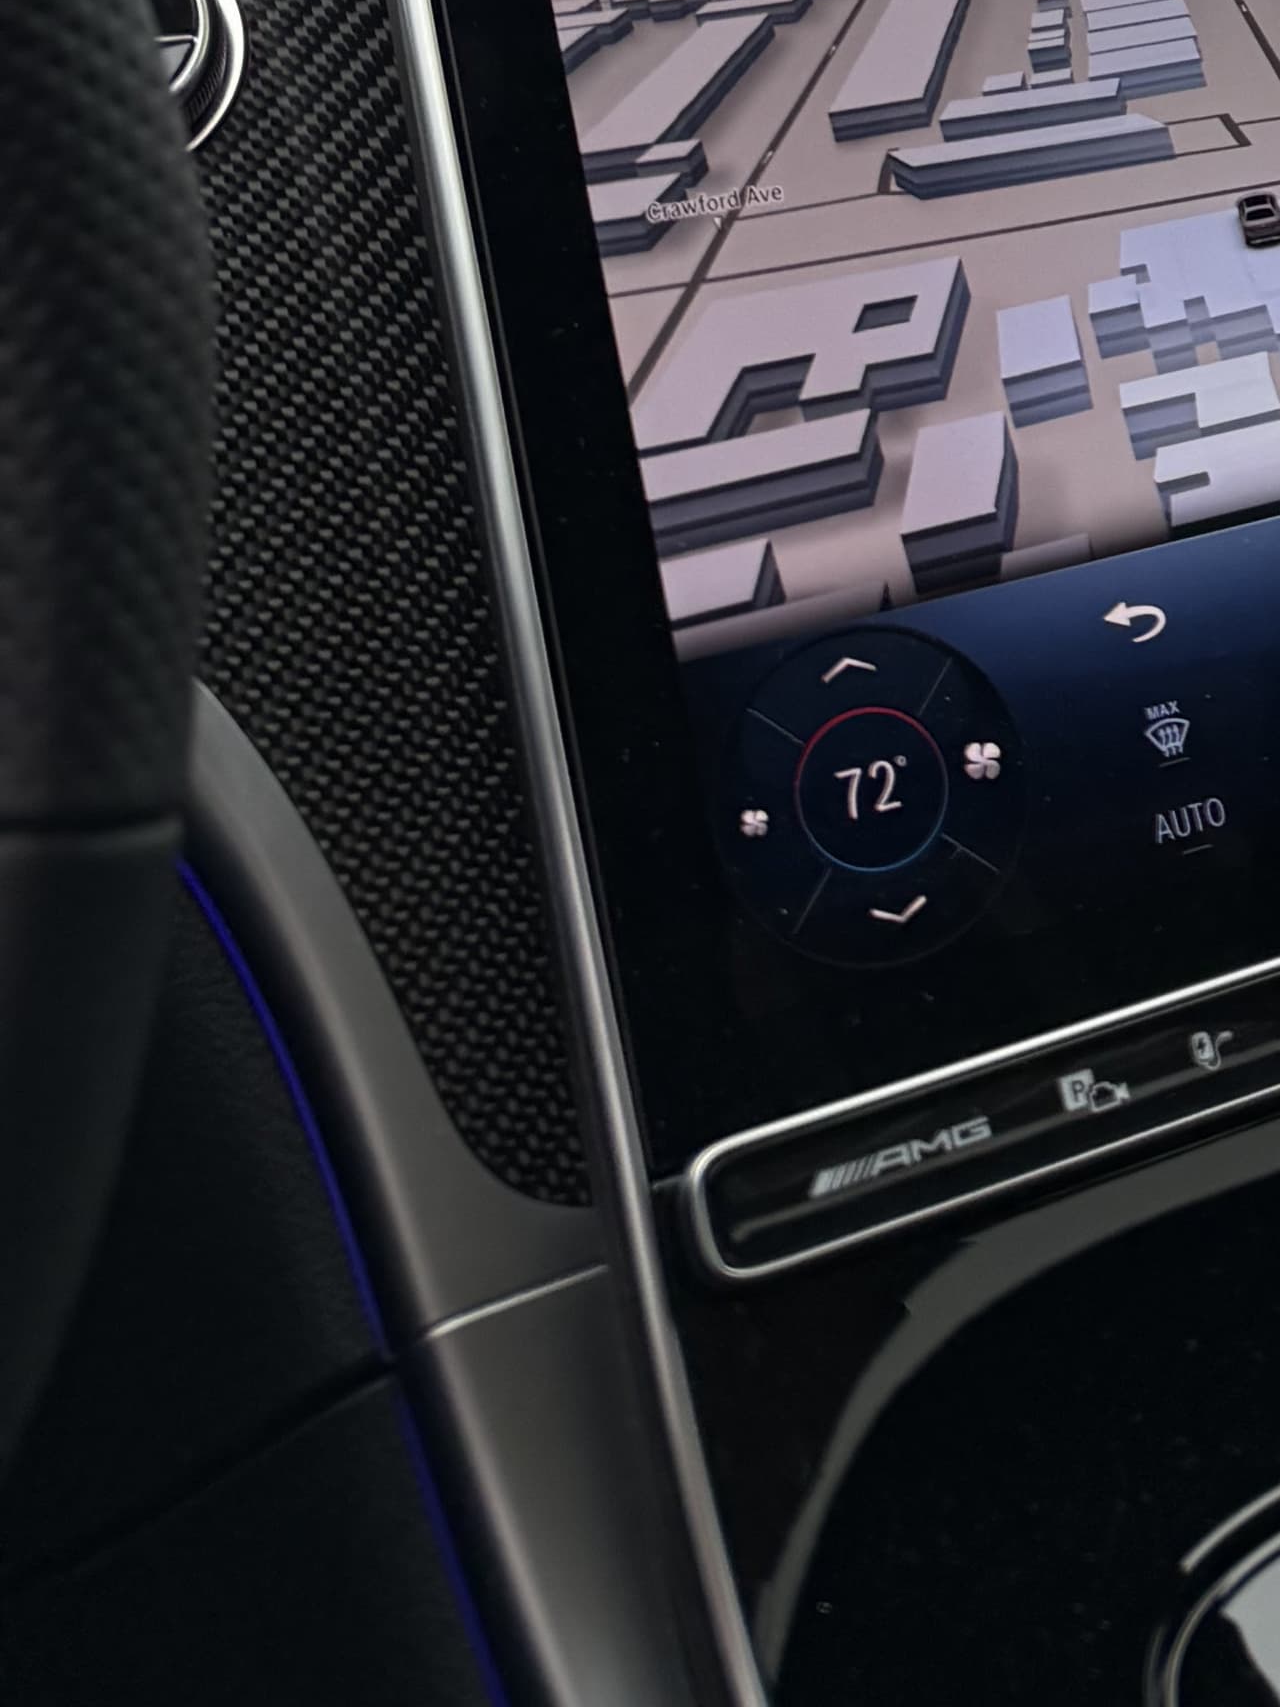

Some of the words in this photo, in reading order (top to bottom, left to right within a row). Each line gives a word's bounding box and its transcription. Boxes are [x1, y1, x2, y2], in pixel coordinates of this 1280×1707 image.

[647, 194, 742, 223] Crawford
[742, 186, 783, 207] Ave
[1145, 700, 1180, 720] MAX
[1155, 797, 1227, 844] AUTO
